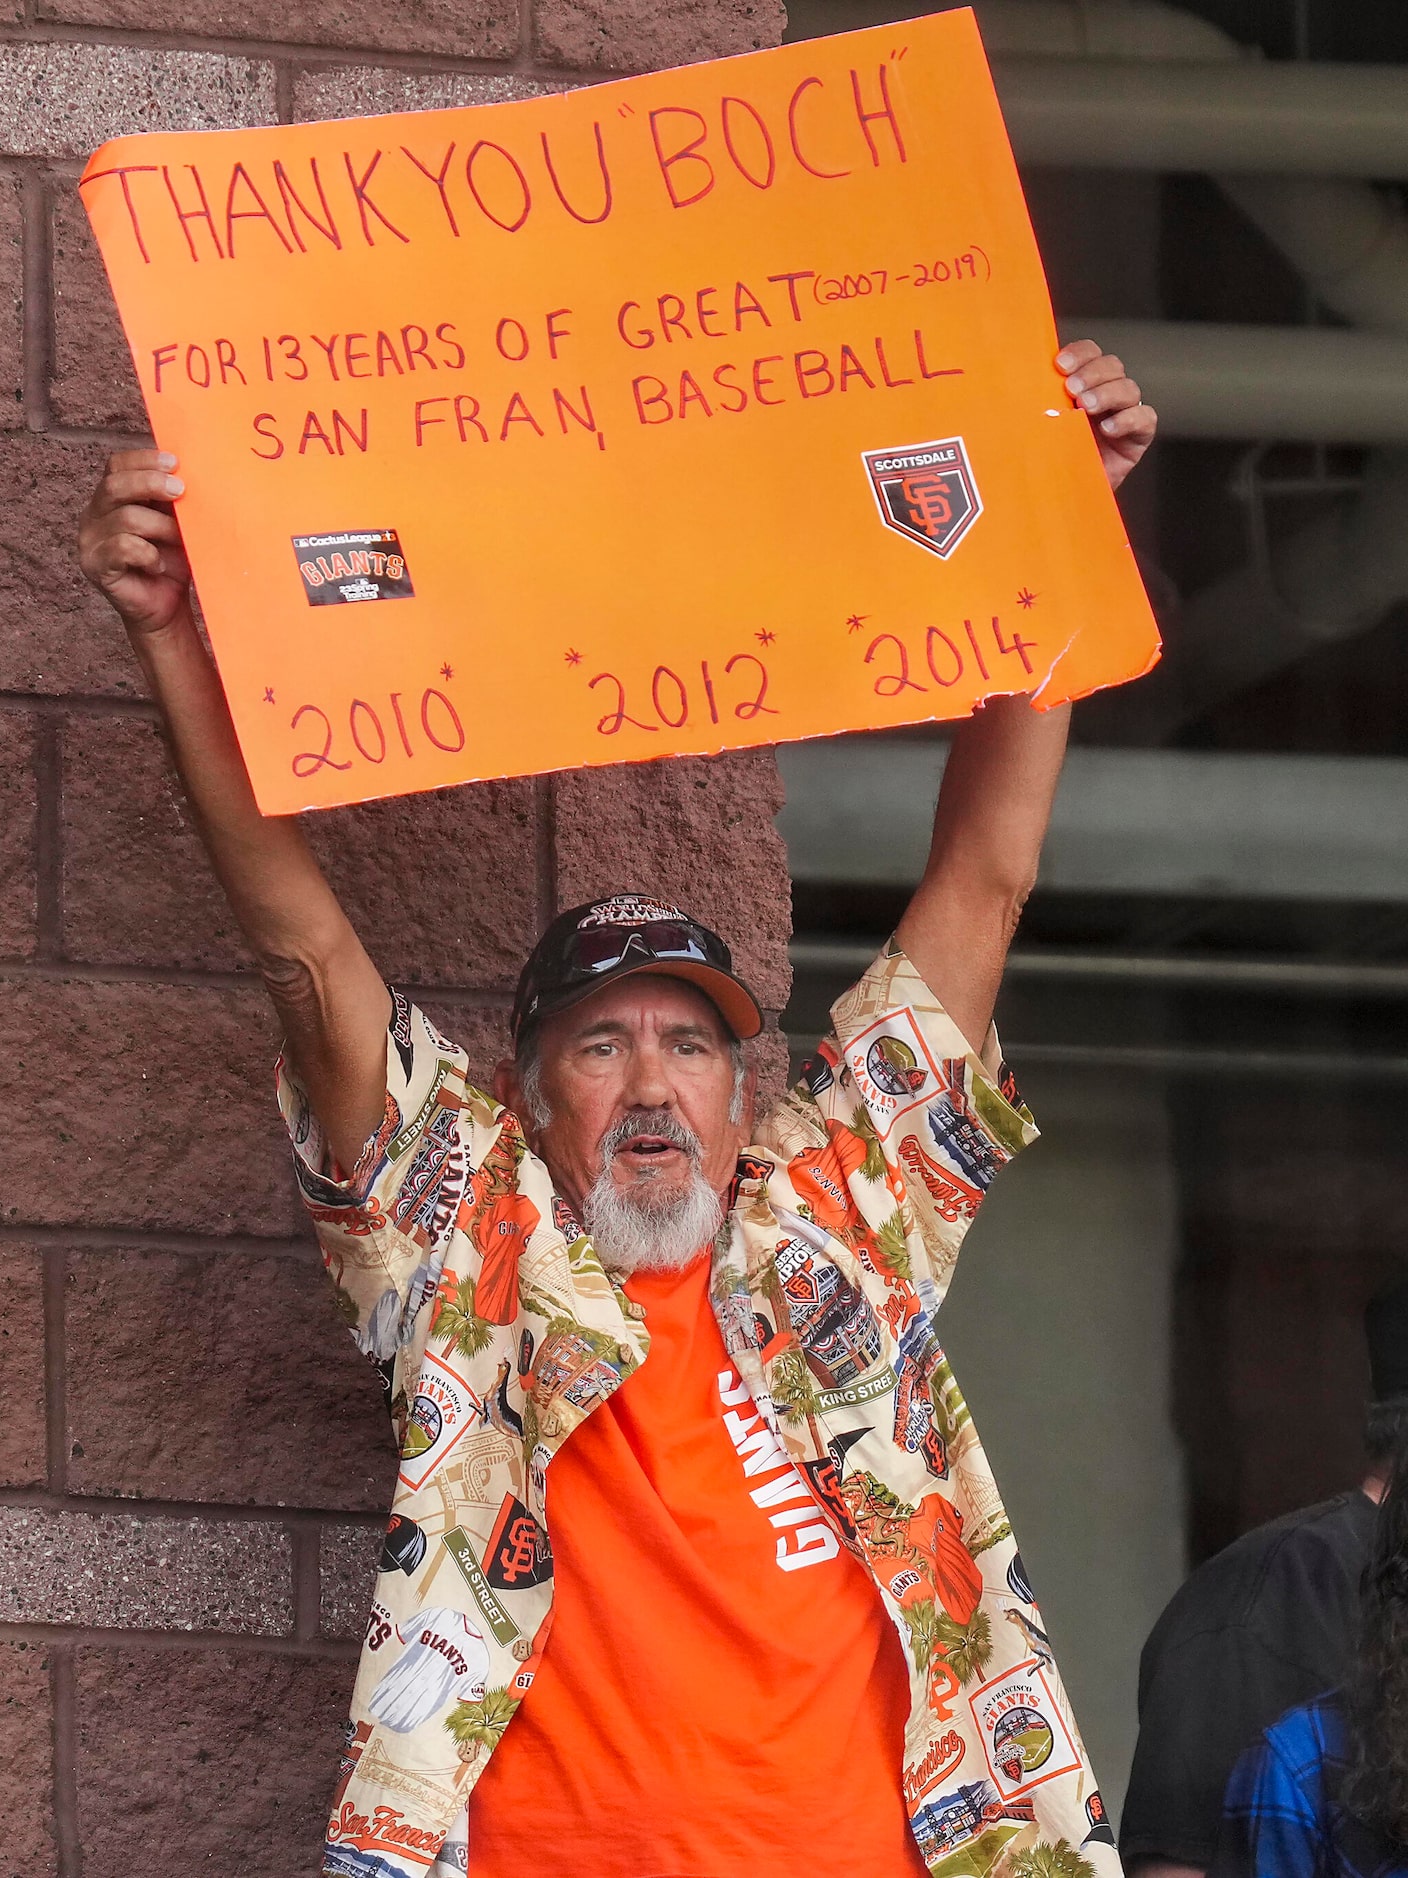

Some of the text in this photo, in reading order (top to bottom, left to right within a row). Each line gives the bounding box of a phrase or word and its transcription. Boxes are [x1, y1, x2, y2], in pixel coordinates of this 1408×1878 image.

[152, 338, 246, 393] FOR
[495, 308, 573, 361] OF
[617, 270, 815, 349] GREAT
[250, 407, 369, 460] SAN
[631, 329, 966, 425] BASEBALL
[873, 449, 957, 472] SCOTTSDALE
[299, 550, 405, 587] GIANTS
[395, 1101, 432, 1152] STREET
[418, 1380, 457, 1425] IANTS
[818, 1370, 894, 1409] KING STREE
[499, 1516, 538, 1583] SF
[457, 1547, 506, 1626] 3rd STREET
[419, 1628, 469, 1677] GIANTS
[986, 1692, 1041, 1732] GIANTS
[991, 1684, 1033, 1704] FRANCISCO
[325, 1801, 371, 1842] San
